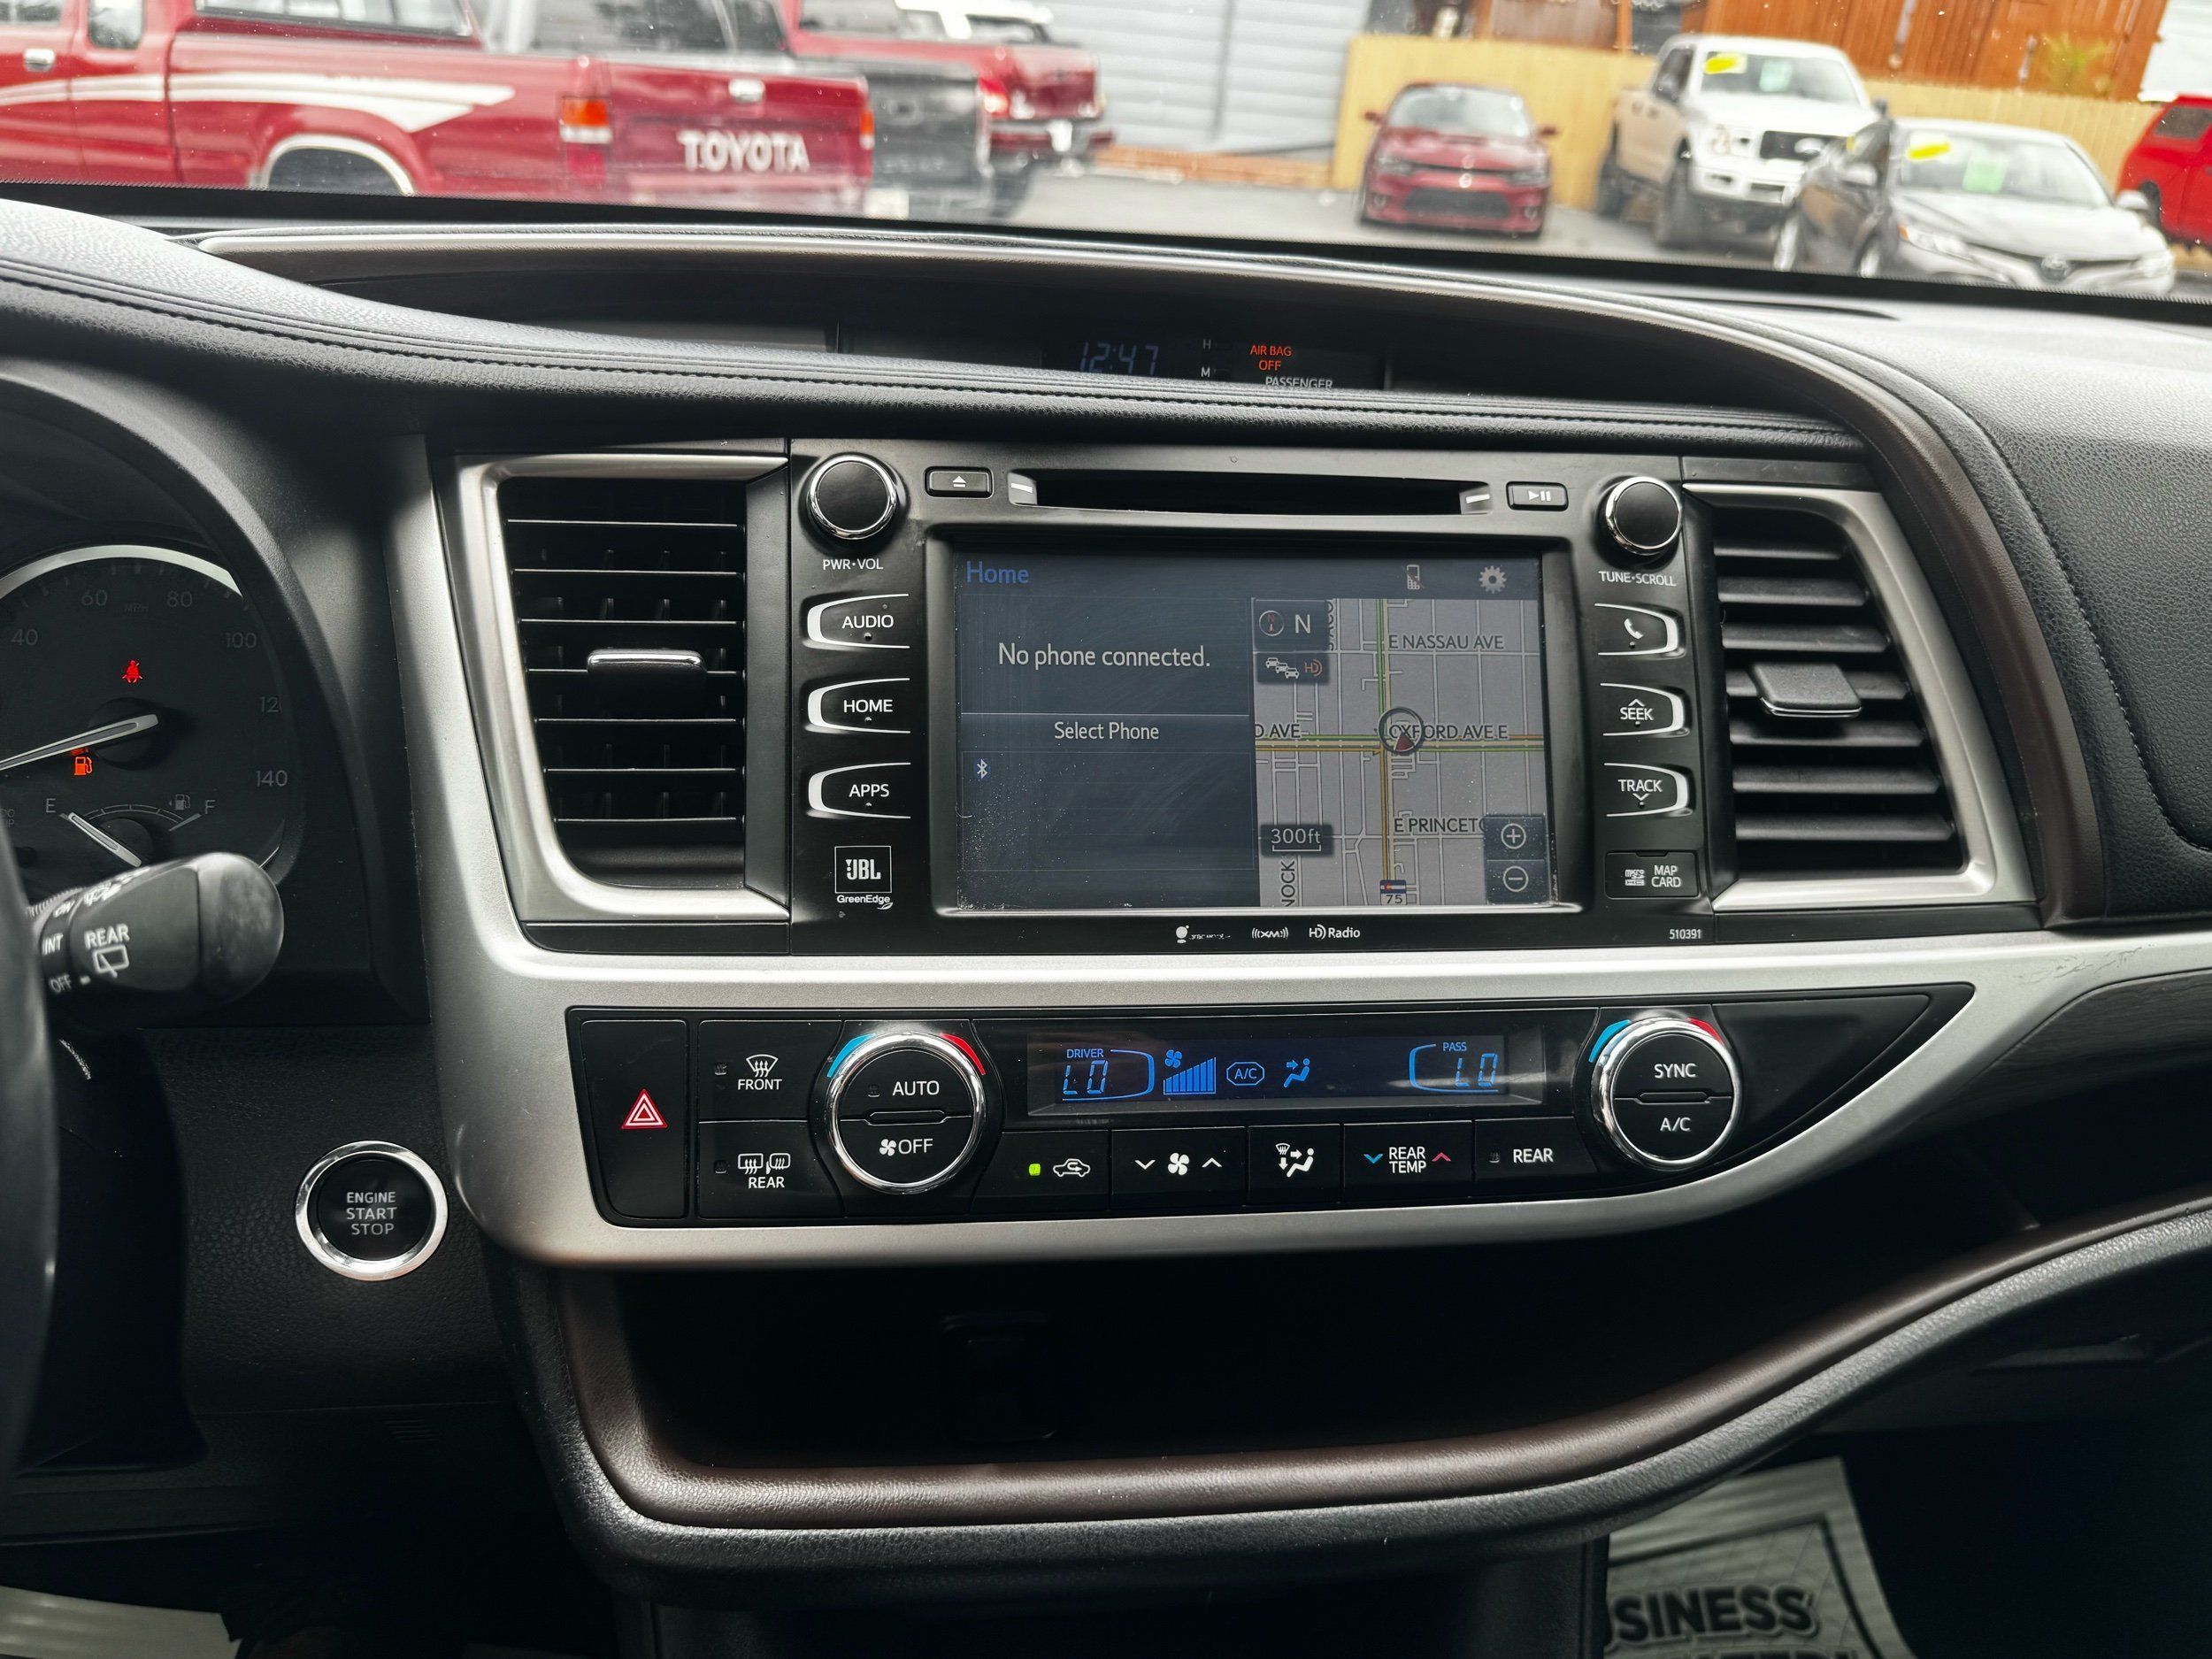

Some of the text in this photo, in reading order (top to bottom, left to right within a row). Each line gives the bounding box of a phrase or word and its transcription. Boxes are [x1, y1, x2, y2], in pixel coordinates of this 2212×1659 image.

[676, 130, 810, 173] TOYOTA
[1202, 340, 1211, 349] H
[1250, 345, 1292, 357] AIR BAG
[1079, 341, 1159, 376] 12:47
[1258, 360, 1281, 371] OFF
[1201, 367, 1210, 378] M
[1265, 376, 1333, 388] PASSENGER
[966, 561, 1030, 584] Home
[81, 589, 108, 607] 60
[166, 590, 193, 609] 80
[124, 603, 150, 613] MPH
[842, 615, 895, 629] AUDIO
[1294, 614, 1311, 634] N
[11, 629, 38, 647] 40
[225, 632, 257, 649] 100
[1389, 635, 1504, 649] E NASSAU AVE
[998, 642, 1210, 670] No phone connected.
[843, 699, 893, 713] HOME
[1620, 707, 1654, 721] SEEK
[1054, 721, 1159, 740] Select Phone
[1270, 724, 1301, 738] AVE
[1389, 725, 1508, 739] OXFORD AVE E
[256, 770, 288, 787] 140
[849, 784, 890, 797] APPS
[1618, 780, 1663, 792] TRACK
[46, 798, 56, 813] E
[204, 800, 216, 814] F
[1394, 818, 1404, 832] E
[1271, 828, 1321, 844] 300ft
[846, 859, 881, 879] JBL
[1654, 865, 1678, 876] MAP
[1651, 877, 1682, 887] CARD
[836, 895, 891, 905] GreenEdge
[1386, 895, 1403, 904] 75
[84, 923, 130, 949] REAR
[1328, 927, 1361, 939] Radio
[1669, 929, 1701, 940] 510391
[42, 933, 64, 956] INT
[49, 974, 72, 994] OFF
[1066, 1048, 1104, 1058] DRIVER
[1442, 1041, 1467, 1052] PASS
[1234, 1068, 1257, 1080] A/C
[1654, 1063, 1697, 1079] SYNC
[737, 1079, 782, 1090] FRONT
[892, 1080, 940, 1096] AUTO
[1660, 1117, 1692, 1132] A/C
[898, 1138, 933, 1155] OFF
[1388, 1147, 1426, 1160] REAR
[1512, 1148, 1554, 1164] REAR
[1389, 1160, 1426, 1174] TEMP
[748, 1177, 785, 1189] REAR
[346, 1191, 396, 1203] ENGINE
[346, 1207, 397, 1220] START
[350, 1223, 395, 1235] STOP
